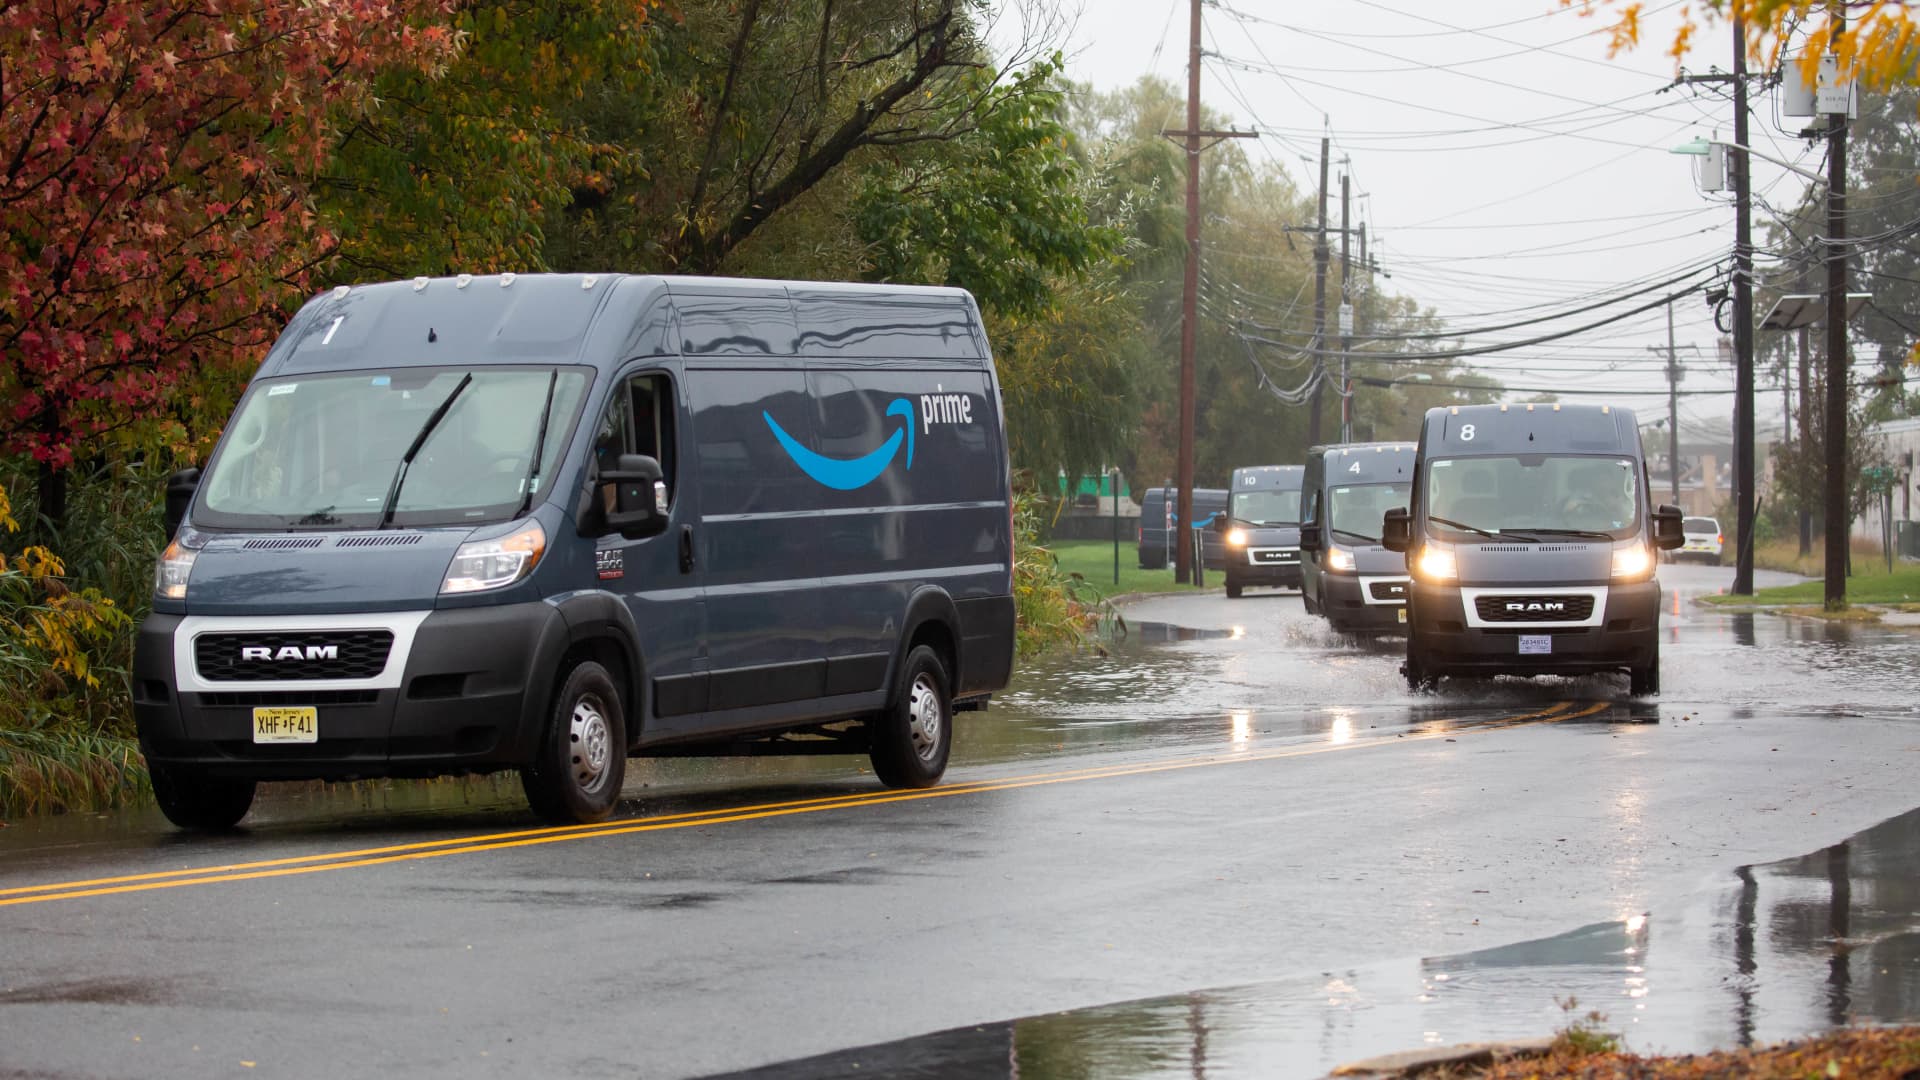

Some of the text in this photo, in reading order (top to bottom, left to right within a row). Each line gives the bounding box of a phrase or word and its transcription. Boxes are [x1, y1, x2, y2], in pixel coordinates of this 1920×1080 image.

[321, 316, 345, 345] 1
[920, 384, 972, 434] prime
[1460, 424, 1475, 441] 8
[1349, 461, 1361, 474] 4
[1244, 475, 1256, 486] 10
[1506, 602, 1564, 612] RAM
[242, 645, 338, 661] RAM
